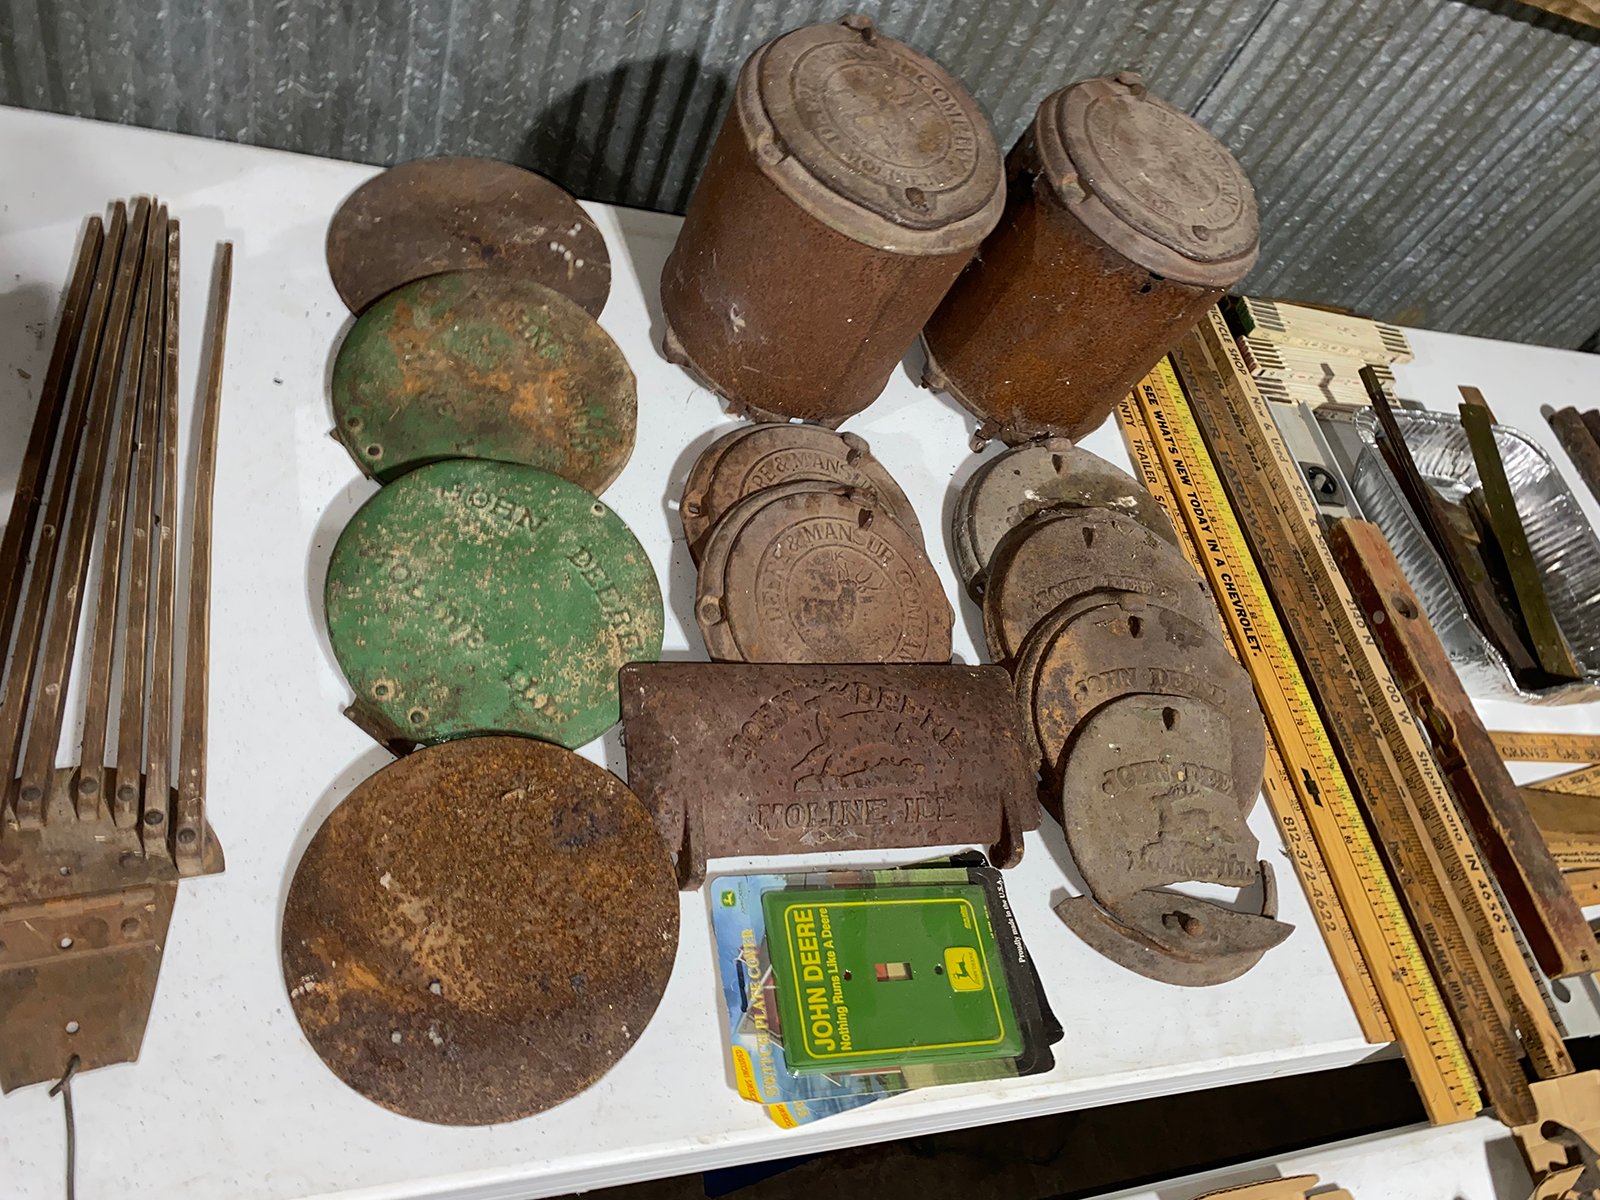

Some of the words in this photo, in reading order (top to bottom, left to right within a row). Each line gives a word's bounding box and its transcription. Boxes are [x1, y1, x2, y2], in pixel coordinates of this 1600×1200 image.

[1143, 384, 1157, 406] SEE
[1154, 410, 1177, 454] WHAT'S
[1173, 457, 1190, 487] NEW
[1187, 491, 1210, 534] TODAY
[1206, 537, 1219, 553] IN
[1215, 556, 1224, 566] A
[1221, 571, 1262, 656] CHEVROLET.
[1228, 346, 1246, 376] SHOP
[1251, 395, 1266, 418] New
[1264, 421, 1272, 431] &
[1270, 437, 1288, 464] Used
[1292, 483, 1311, 512] Sales
[1308, 516, 1317, 527] &
[1314, 533, 1338, 572] Service
[1362, 633, 1373, 646] N
[1382, 674, 1400, 703] 700
[1398, 710, 1410, 726] W
[1464, 852, 1478, 872] IN
[1476, 878, 1507, 934] 46565
[1133, 438, 1156, 484] TRAILER
[1281, 817, 1336, 933] 812-372-4622
[1217, 448, 1284, 579] HARDWARE
[1356, 766, 1380, 806] Goods
[1449, 980, 1468, 1010] IOWA
[756, 798, 888, 830] MOLINE
[993, 877, 1007, 898] U.S.A.
[793, 907, 823, 982] DEERE
[818, 907, 831, 937] Deere
[823, 940, 832, 948] A
[1007, 918, 1018, 935] made
[740, 928, 761, 979] COVER
[825, 950, 837, 972] Like
[1010, 934, 1028, 963] Proudly
[747, 983, 768, 1029] PLATE
[829, 975, 843, 1003] Runs
[806, 985, 835, 1052] JOHN
[835, 1006, 853, 1050] Nothing
[754, 1032, 780, 1097] SWITCH
